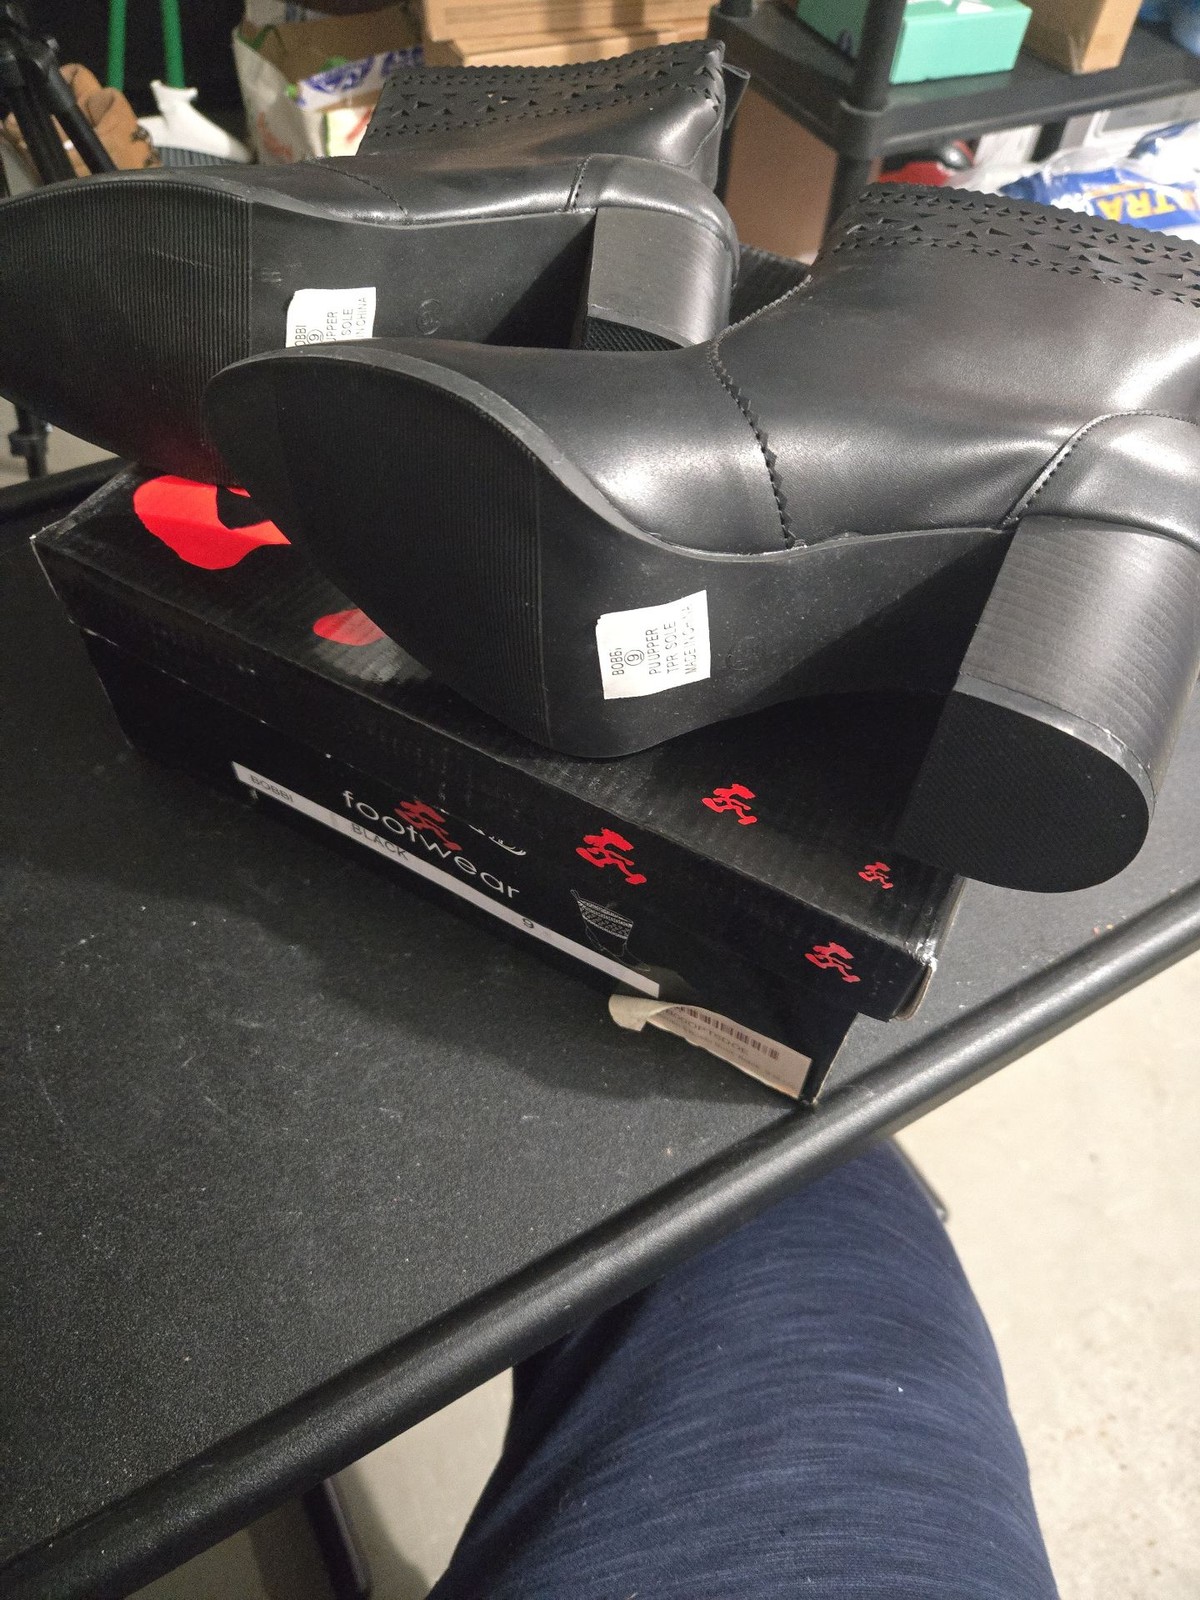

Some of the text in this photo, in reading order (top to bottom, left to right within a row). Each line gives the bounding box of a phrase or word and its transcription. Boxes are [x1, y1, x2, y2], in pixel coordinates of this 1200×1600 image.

[341, 308, 353, 335] SOLE
[355, 297, 367, 326] CHINA
[663, 620, 679, 674] TPR SOLE
[250, 774, 295, 803] BOBBI
[351, 822, 409, 861] BLACK
[522, 917, 535, 930] 9
[341, 789, 520, 899] footwear
